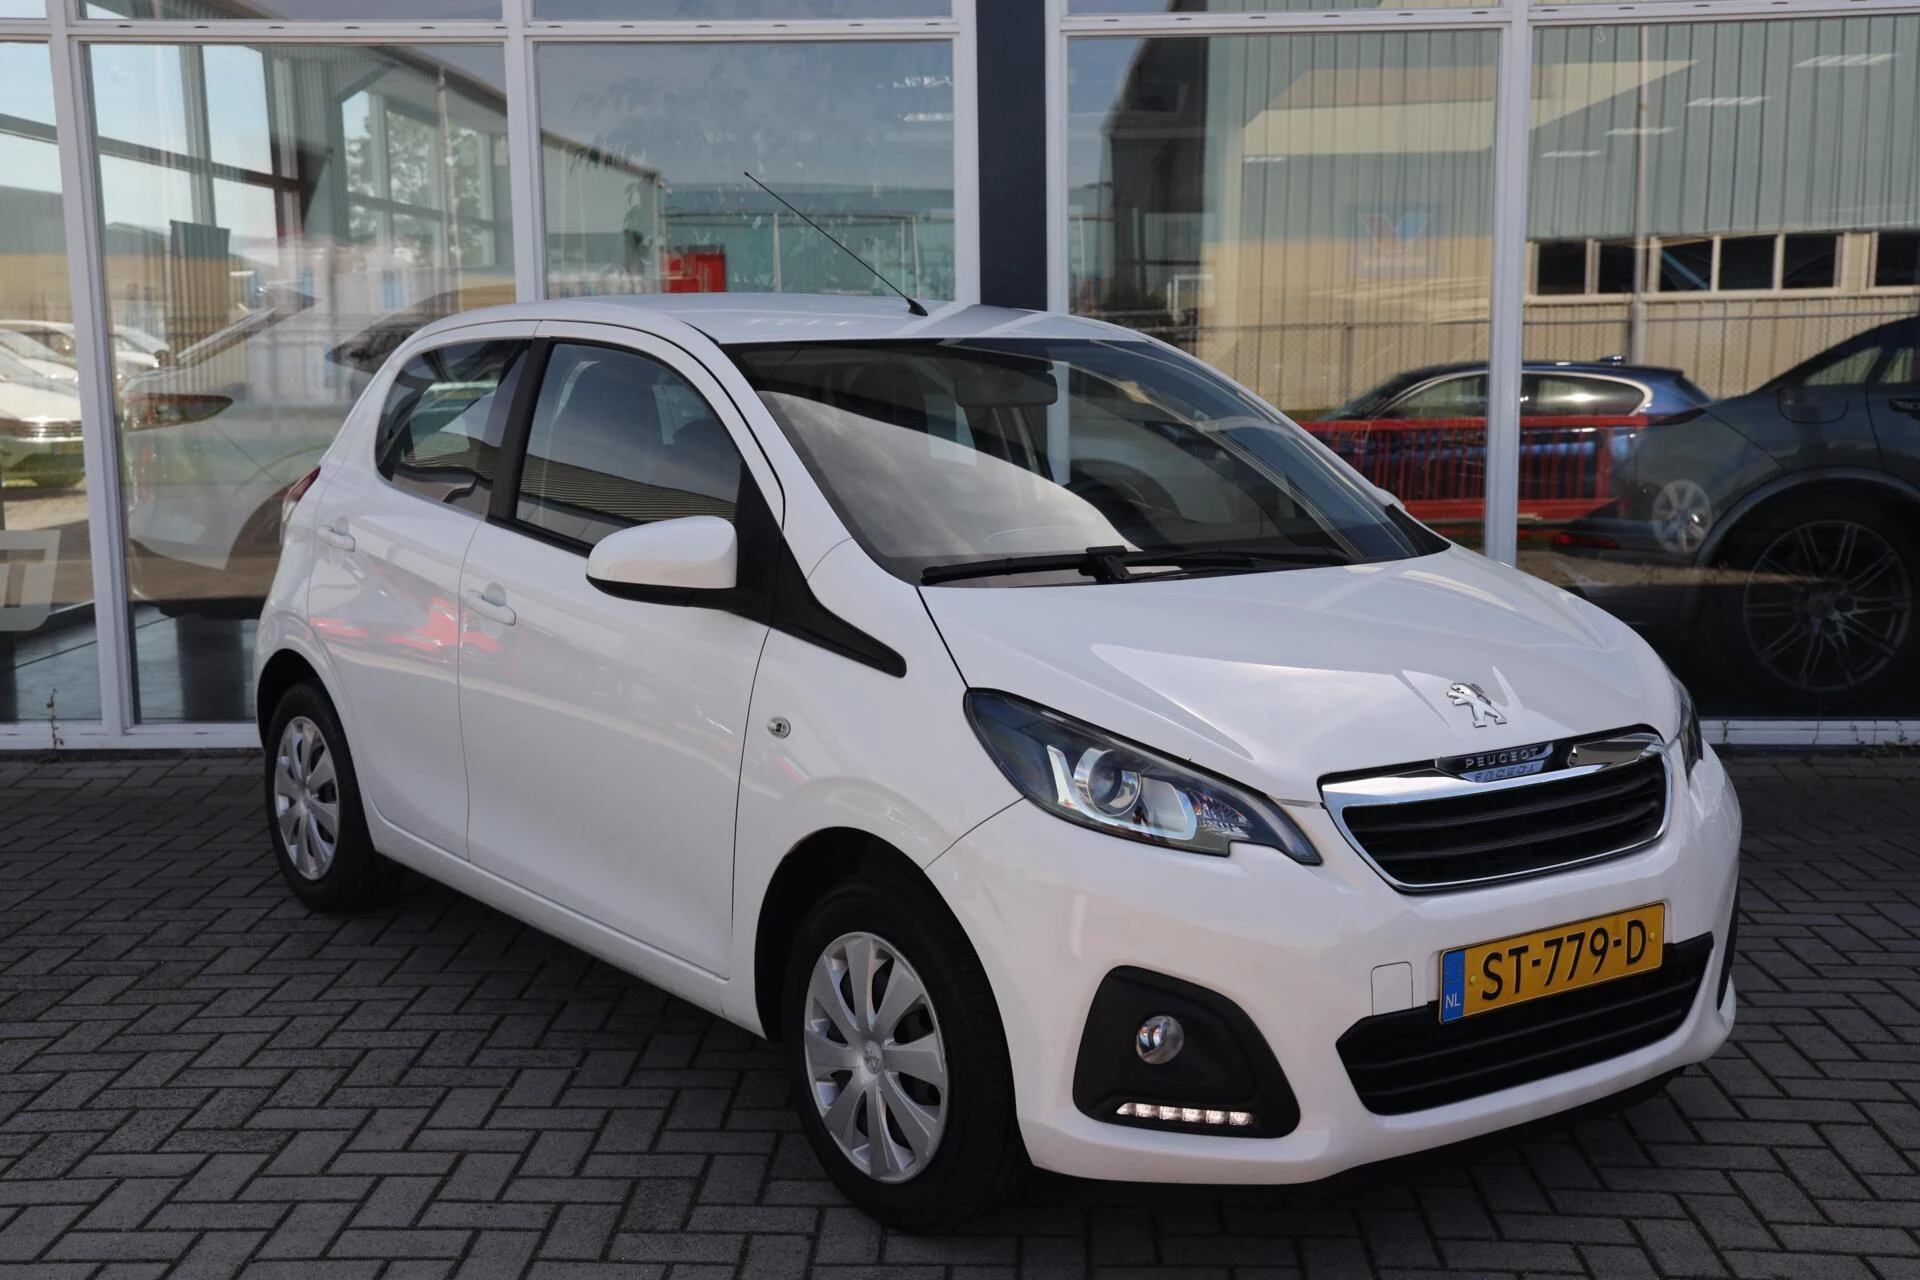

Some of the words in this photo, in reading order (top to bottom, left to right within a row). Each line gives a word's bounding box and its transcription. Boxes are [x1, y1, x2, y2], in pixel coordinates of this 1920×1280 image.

[1465, 748, 1539, 769] PEUGEOT
[1481, 919, 1647, 1001] ST-779-D
[1445, 993, 1461, 1009] NL
